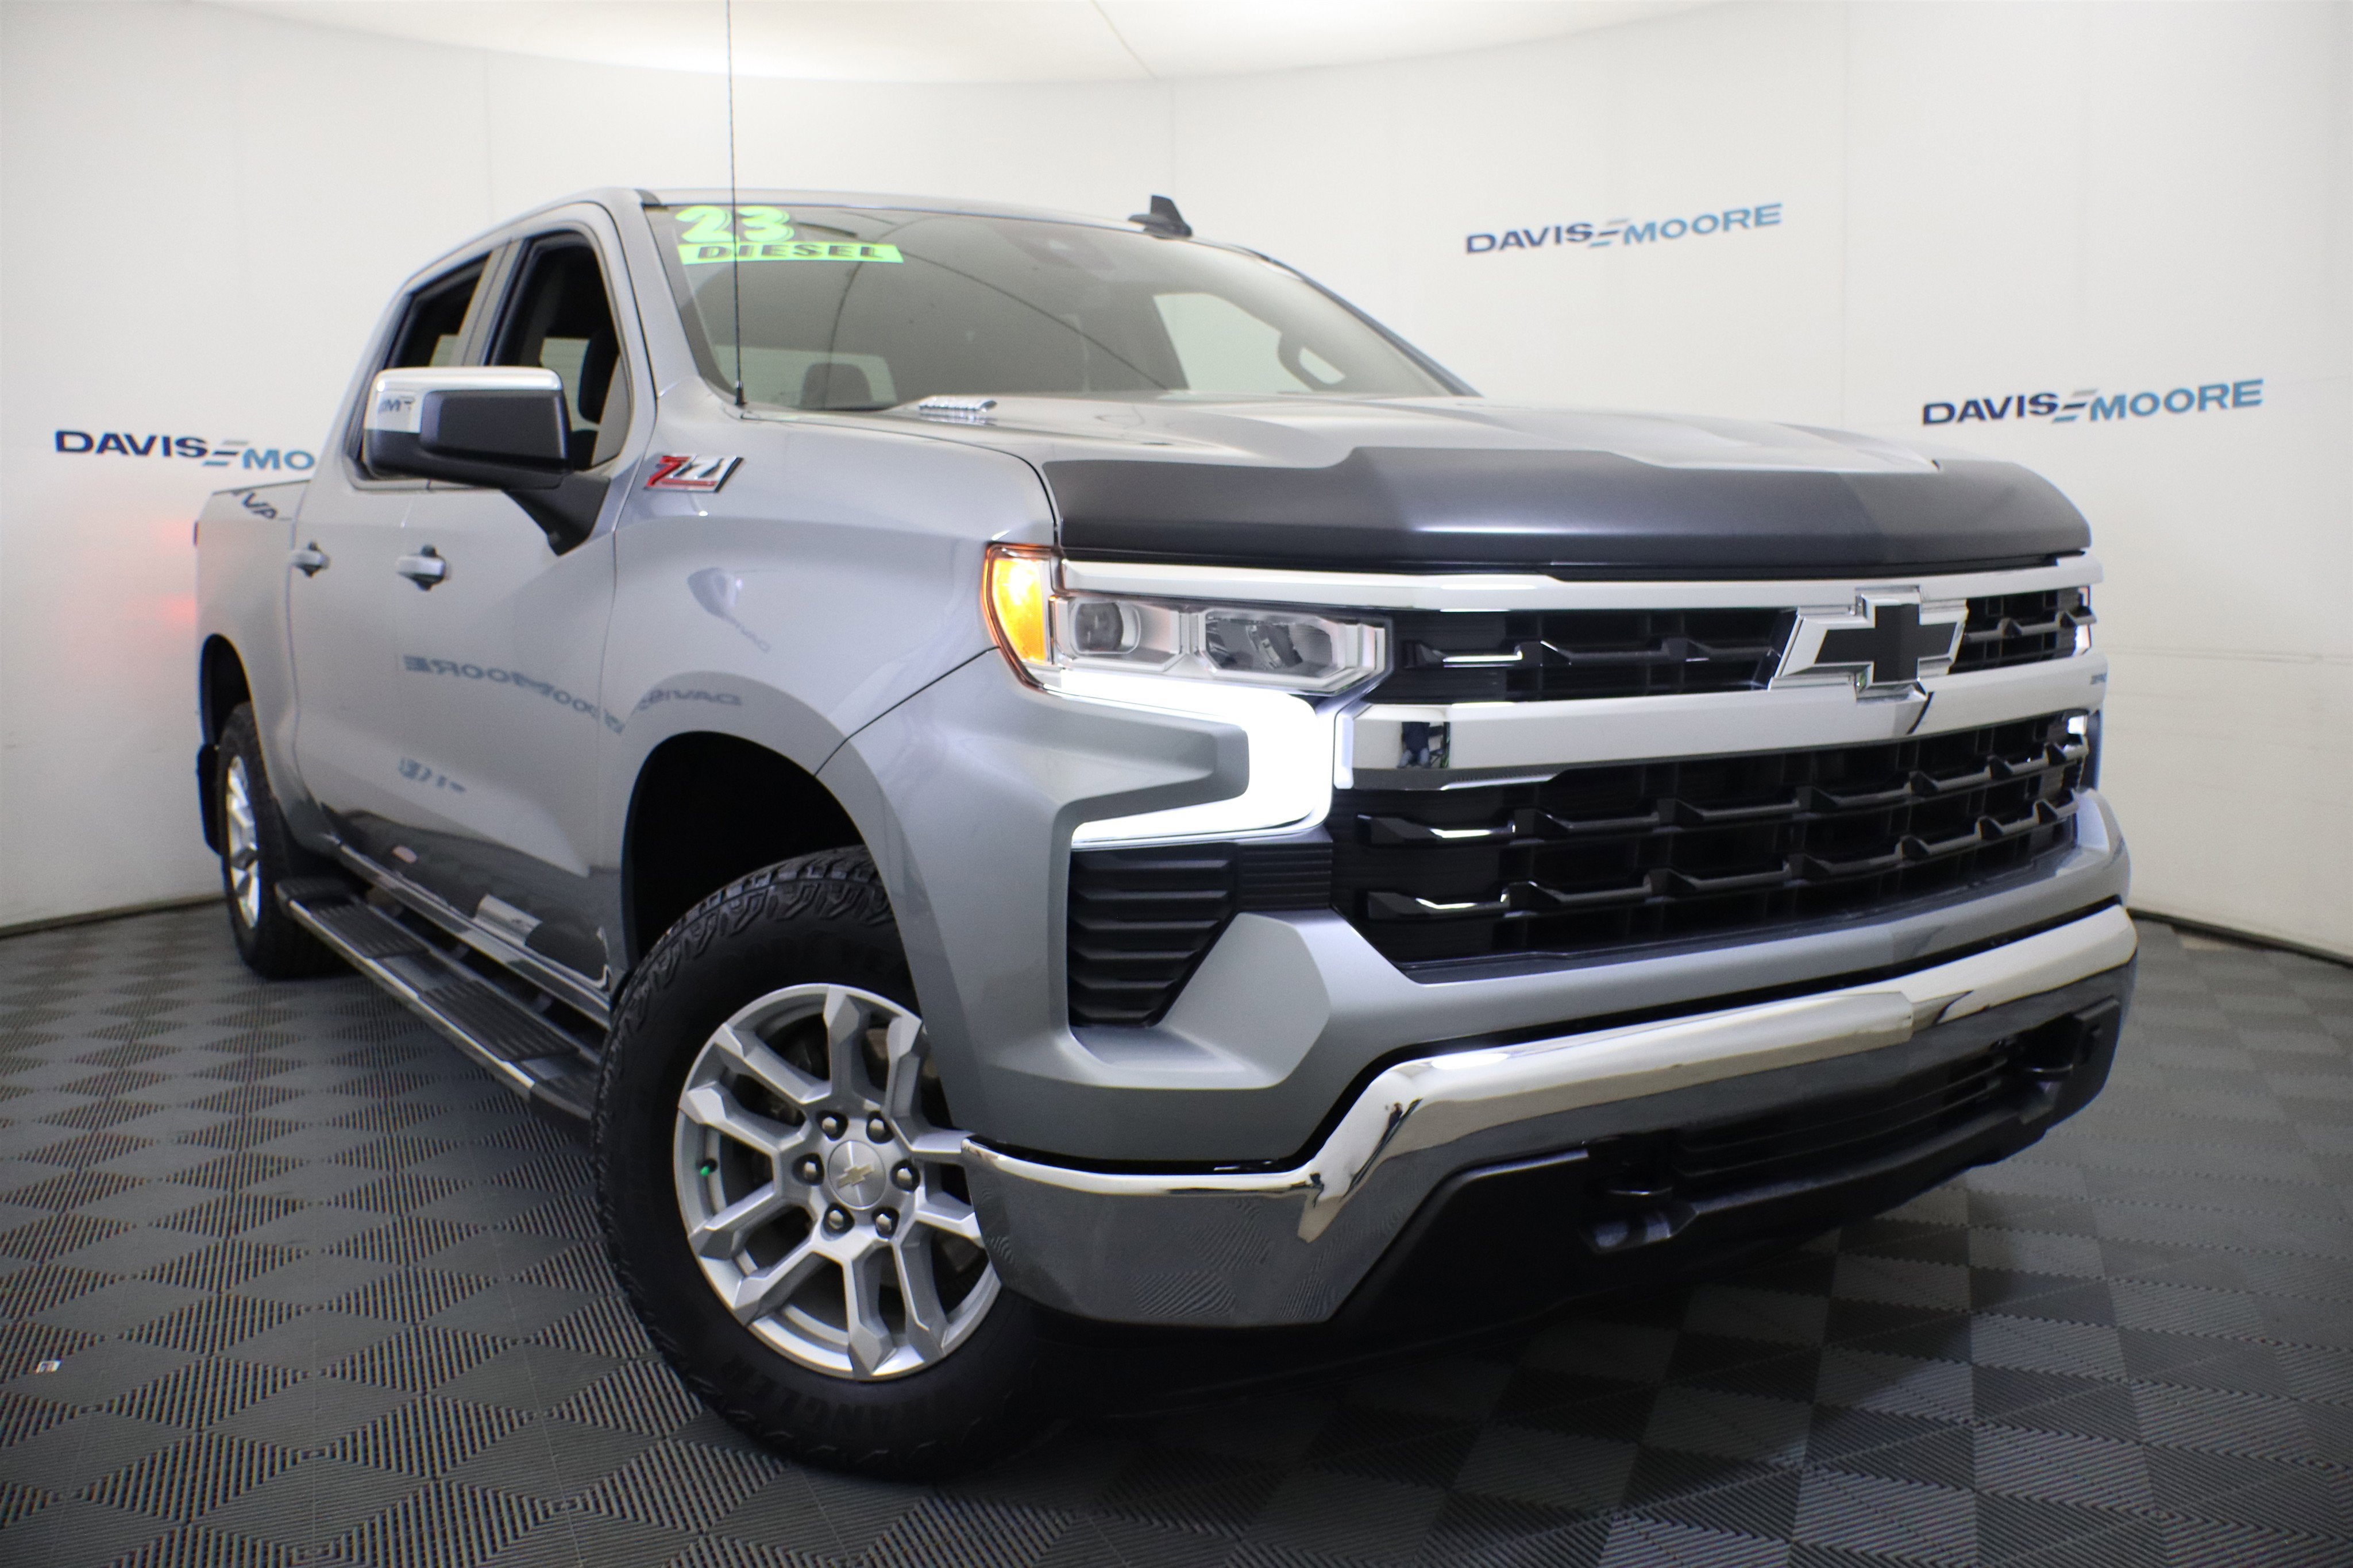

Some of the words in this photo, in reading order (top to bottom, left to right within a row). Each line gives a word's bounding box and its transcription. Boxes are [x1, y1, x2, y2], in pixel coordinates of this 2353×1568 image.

[675, 206, 795, 243] 23
[1466, 223, 1594, 254] DAVIS
[1623, 203, 1783, 245] MOORE
[697, 245, 885, 260] DIESEL
[1922, 392, 2059, 425] DAVIS
[2089, 379, 2264, 422] MOORE
[56, 430, 208, 458] DAVIS
